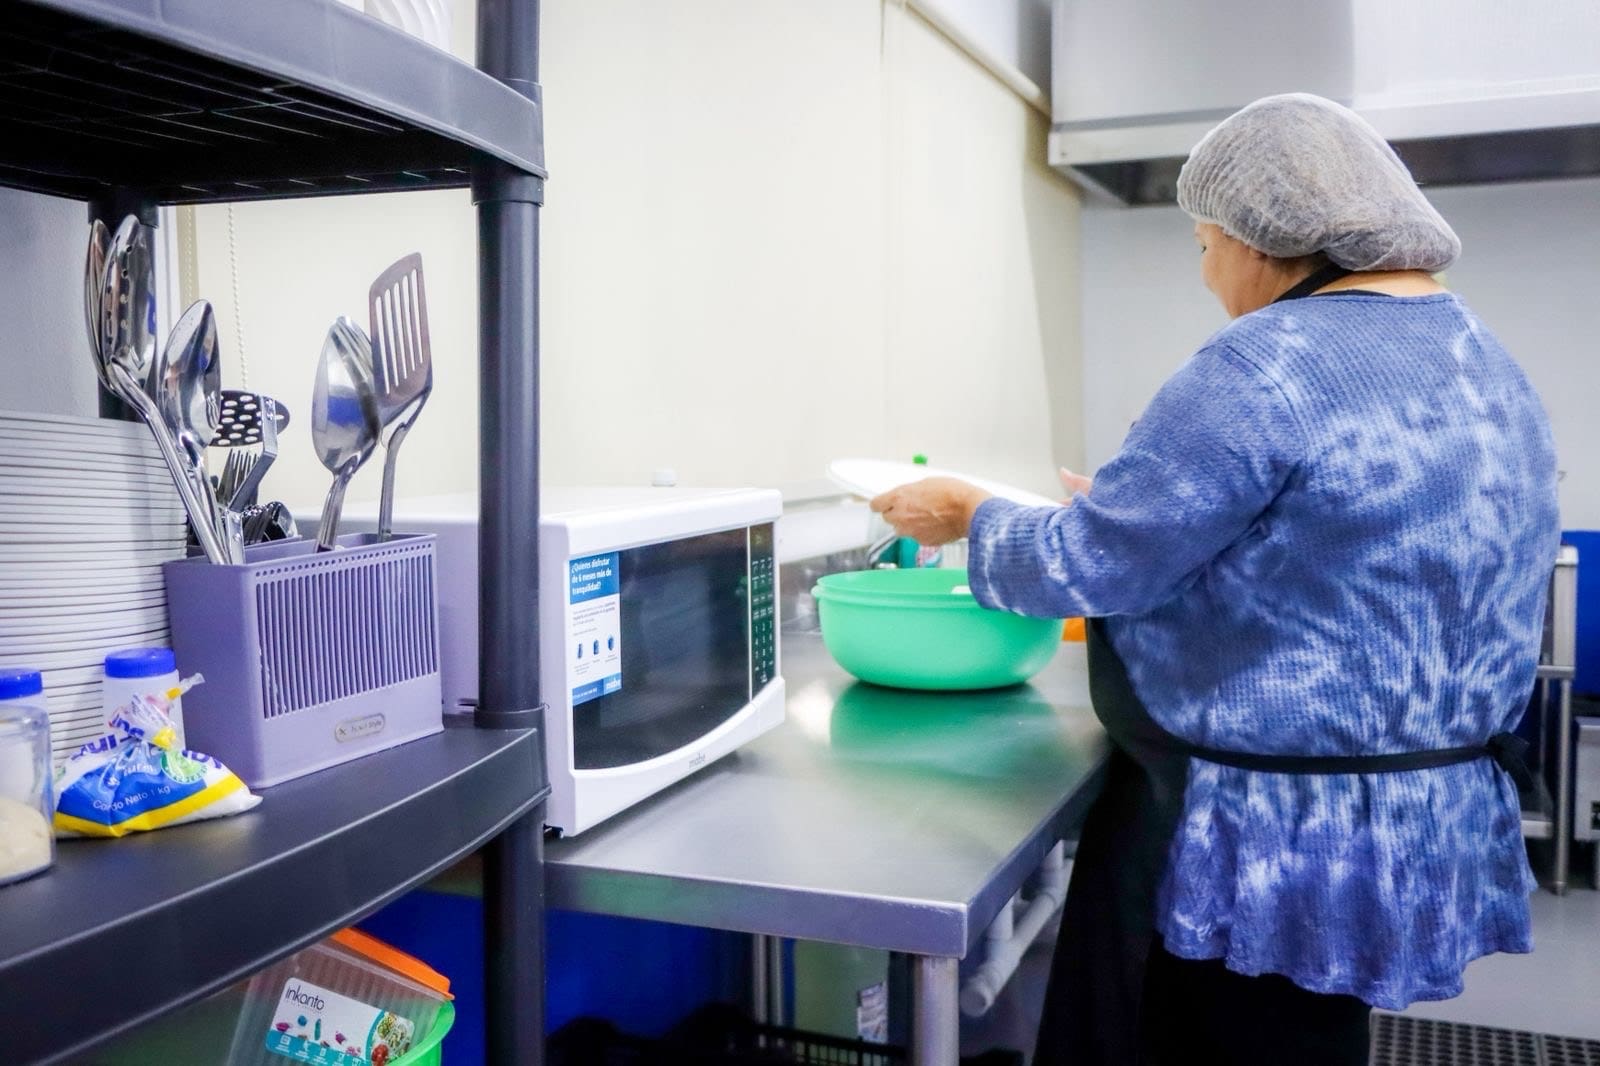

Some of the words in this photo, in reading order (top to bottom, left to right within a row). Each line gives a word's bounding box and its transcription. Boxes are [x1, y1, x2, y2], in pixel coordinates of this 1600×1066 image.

[124, 792, 149, 806] Neto
[157, 785, 171, 795] kg
[285, 985, 325, 1010] inkanto
